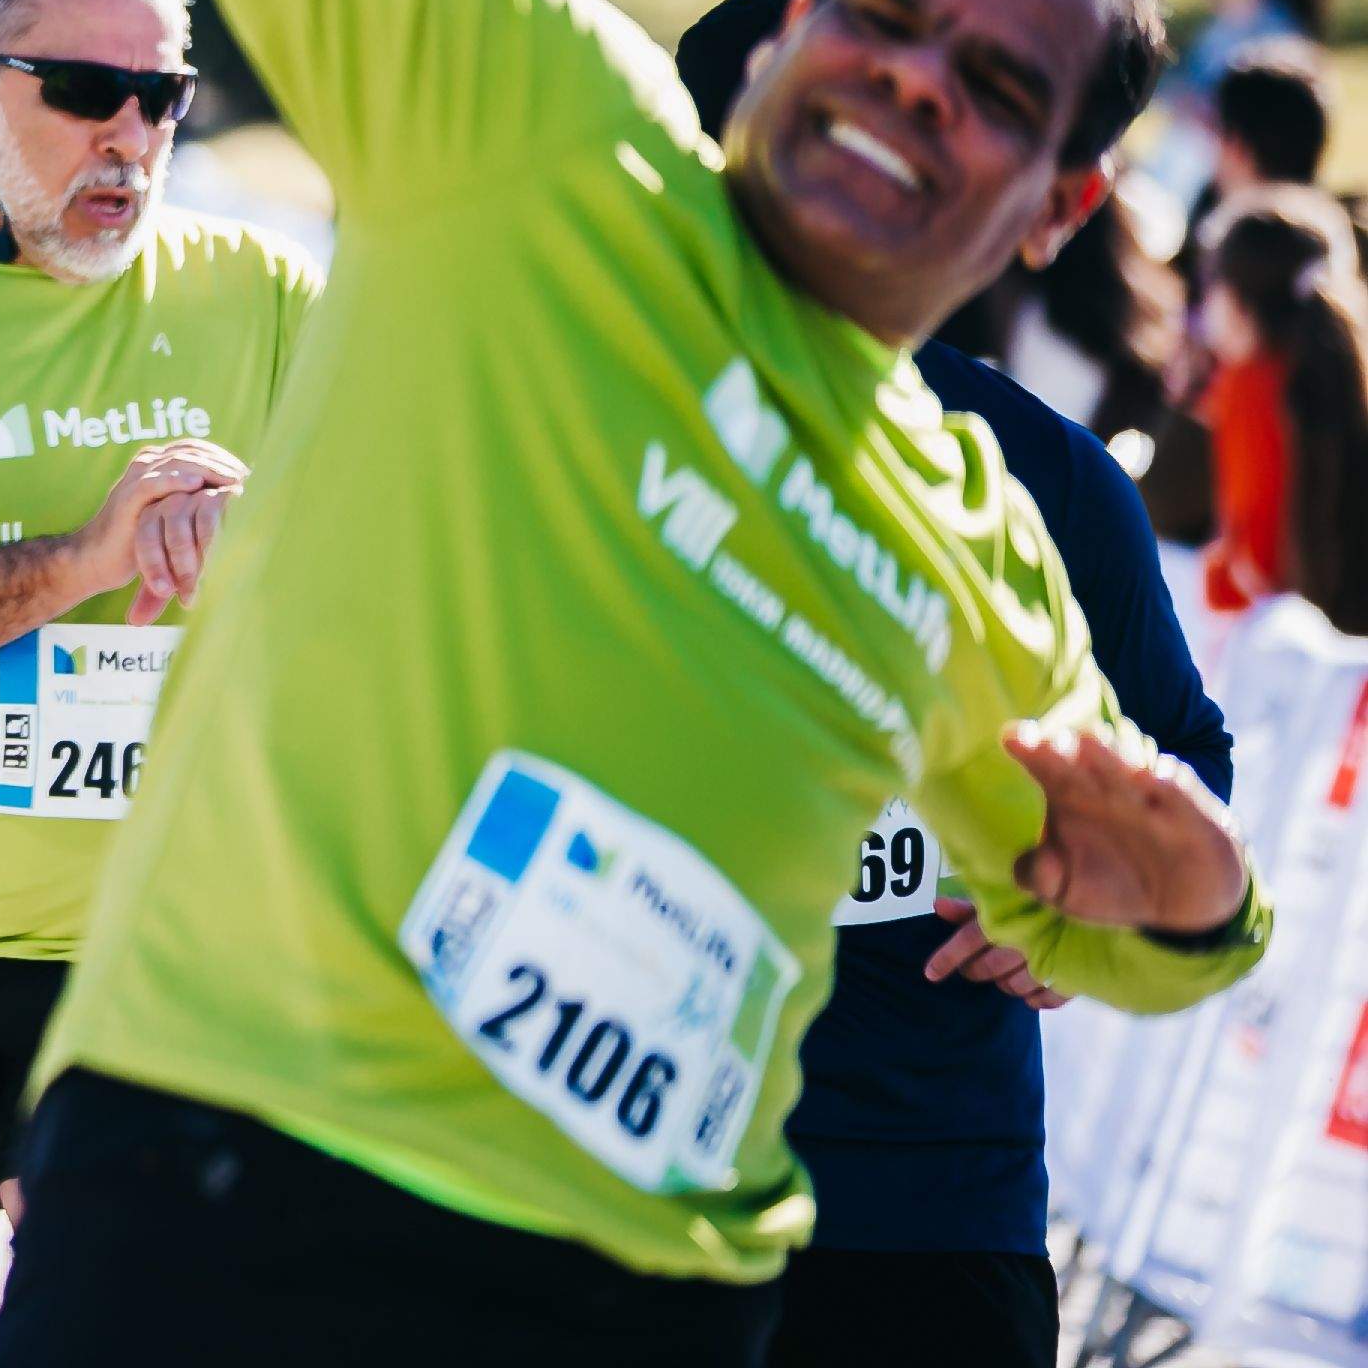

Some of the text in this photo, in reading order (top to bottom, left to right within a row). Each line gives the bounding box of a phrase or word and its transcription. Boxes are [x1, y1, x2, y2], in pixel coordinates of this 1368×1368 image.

[43, 396, 211, 448] MetLife
[48, 739, 145, 799] 246
[849, 827, 925, 903] 69
[477, 964, 677, 1139] 2106
